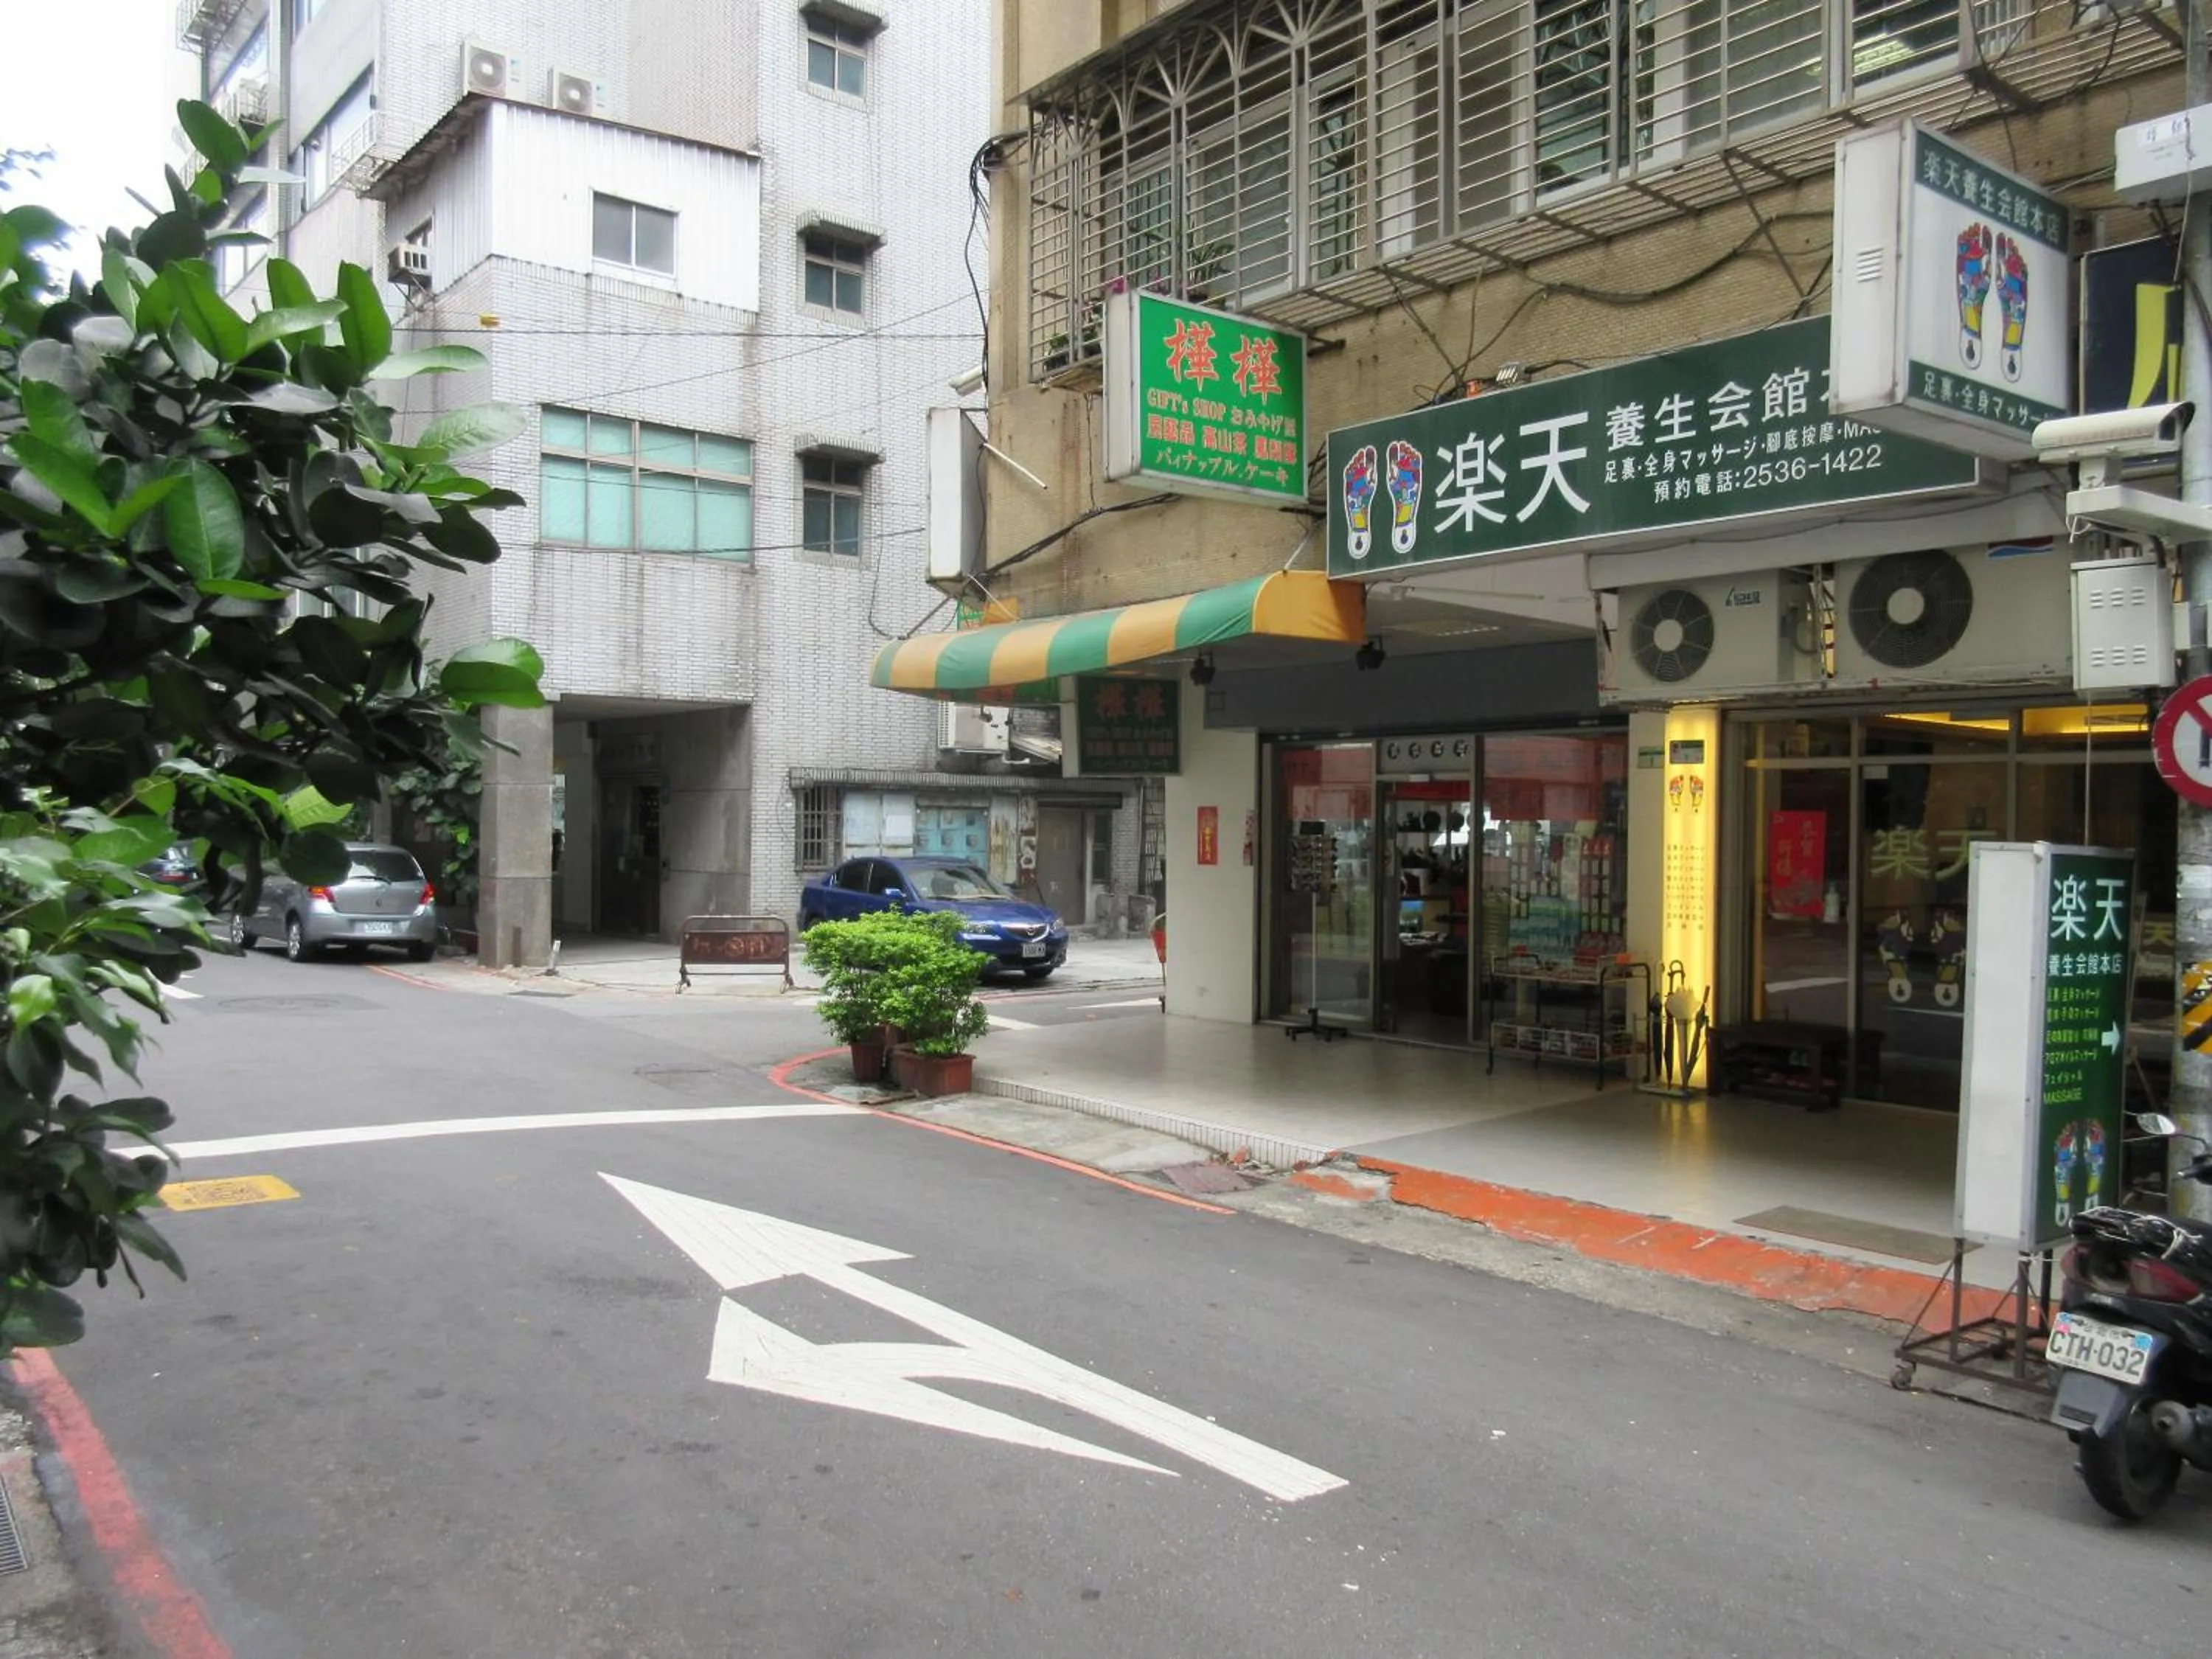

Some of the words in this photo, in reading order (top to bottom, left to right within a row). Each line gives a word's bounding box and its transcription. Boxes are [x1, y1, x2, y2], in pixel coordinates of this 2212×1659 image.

[1433, 411, 1591, 533] 楽天
[1604, 366, 1830, 453] 養生会館
[2050, 874, 2125, 942] 楽天
[2048, 951, 2124, 977] 養生会館本店
